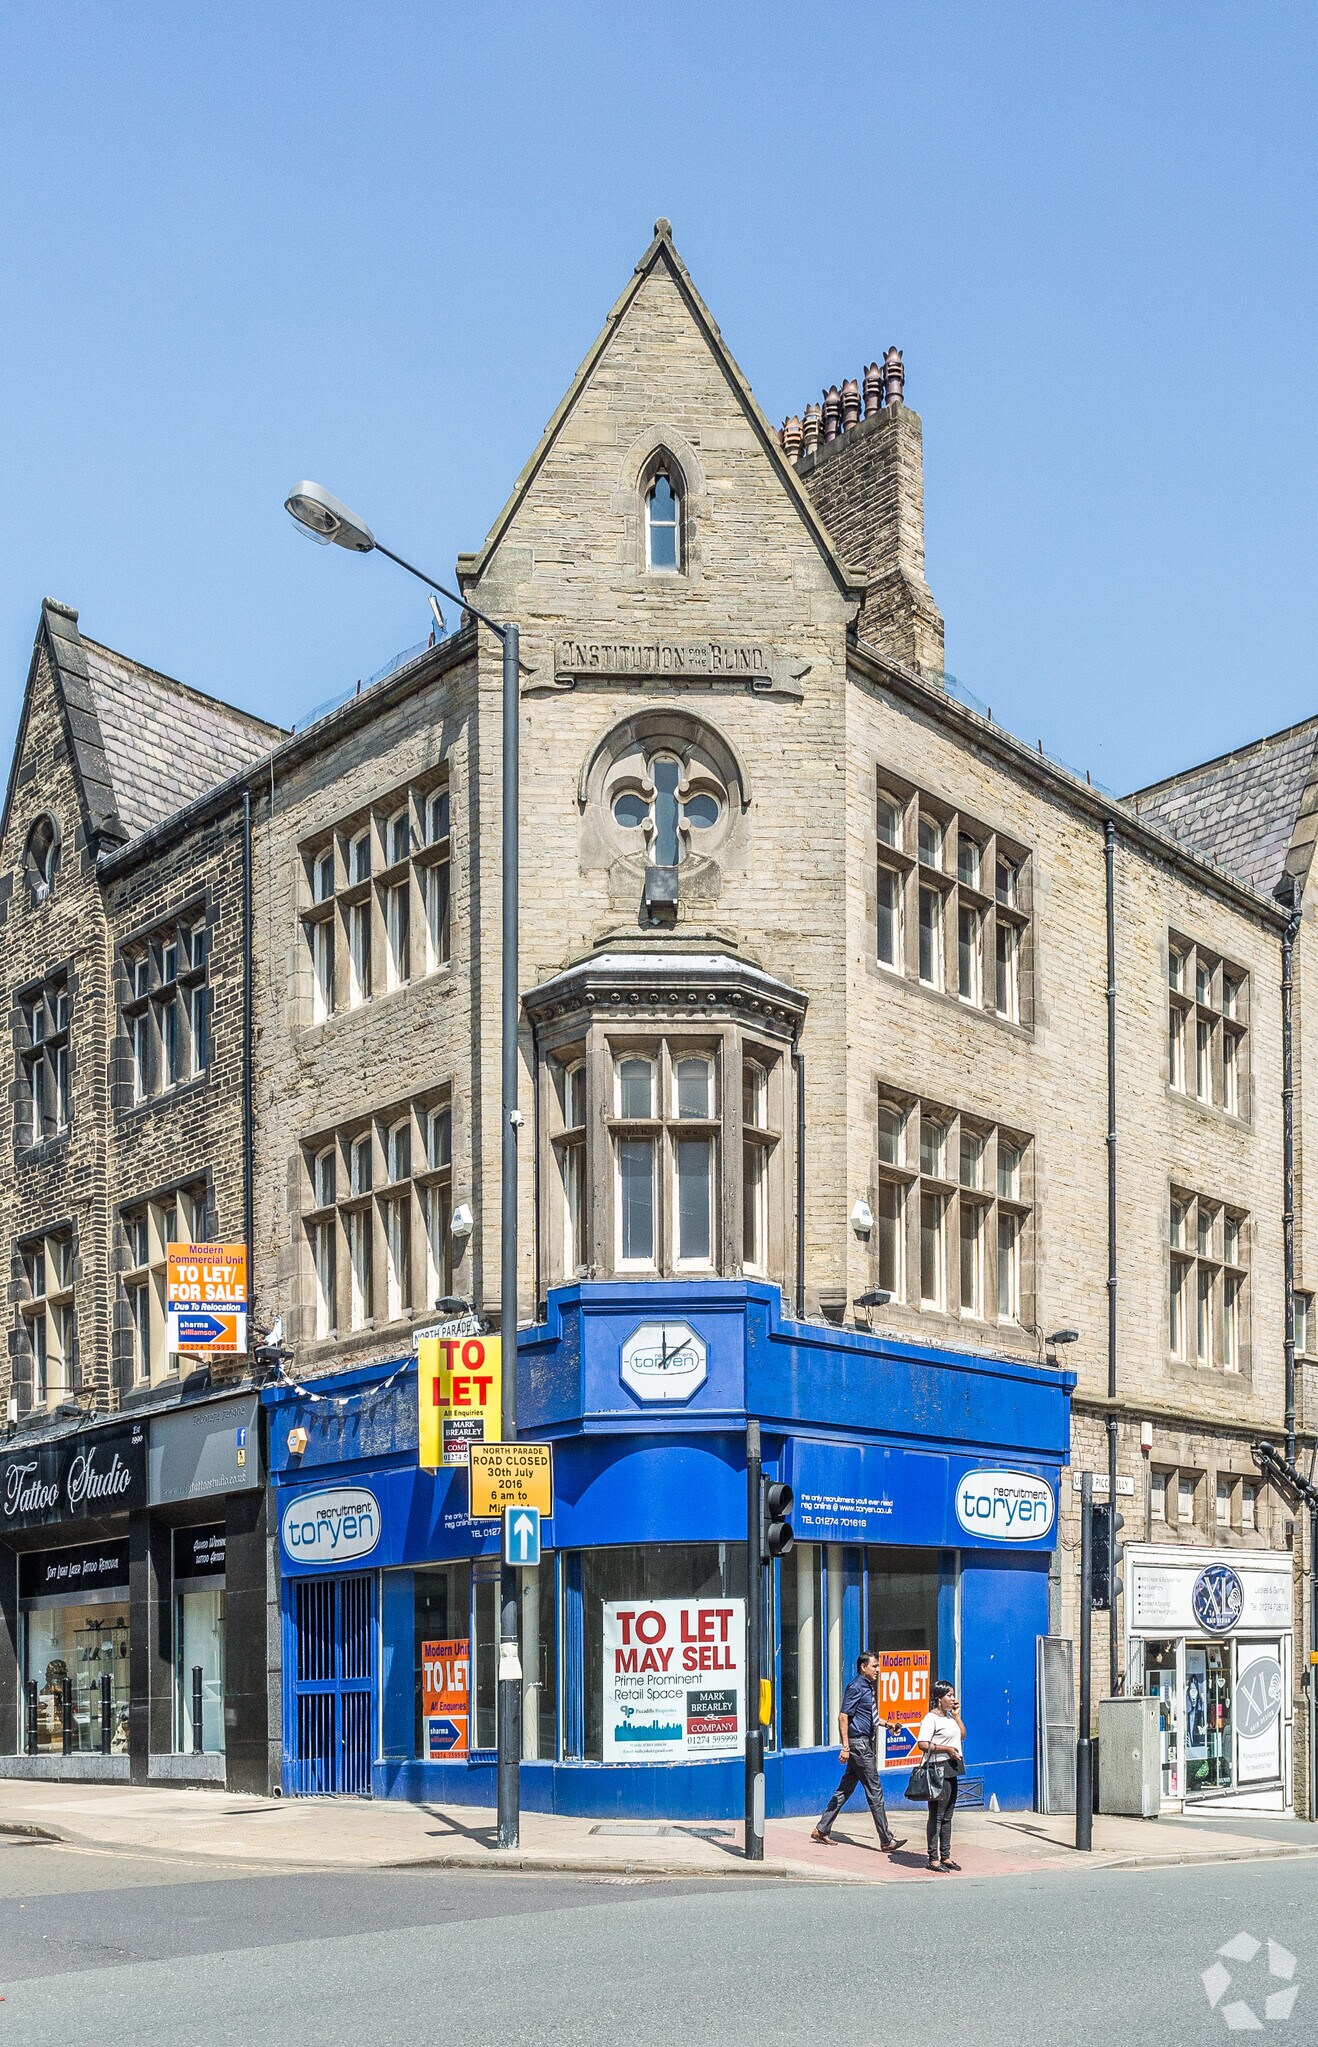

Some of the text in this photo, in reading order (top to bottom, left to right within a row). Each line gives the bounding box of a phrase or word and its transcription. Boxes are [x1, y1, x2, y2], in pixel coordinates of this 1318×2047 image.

[562, 640, 685, 669] INSTITUTION
[688, 648, 707, 656] FOR
[688, 659, 707, 667] THE
[189, 1245, 224, 1254] Modern
[169, 1255, 244, 1265] Commercial Unit
[176, 1265, 237, 1284] TO LET/
[169, 1284, 245, 1301] FOR SALE
[174, 1302, 241, 1311] Due To Relocation
[440, 1339, 486, 1371] TO
[432, 1375, 493, 1407] LET
[454, 1409, 484, 1417] Enquiries
[445, 1428, 482, 1436] BREARLEY
[447, 1444, 468, 1452] COMP
[513, 1447, 544, 1455] PARADE
[473, 1456, 503, 1466] ROAD
[505, 1456, 548, 1466] CLOSED
[487, 1467, 534, 1479] 30th July
[4, 1461, 59, 1515] Tattoo
[67, 1446, 132, 1513] Studio
[498, 1479, 523, 1489] 2016
[1095, 1478, 1129, 1490] PICCILLY
[491, 1491, 497, 1500] 6
[517, 1492, 528, 1500] to
[993, 1486, 1048, 1501] recruitment
[801, 1493, 810, 1501] the
[811, 1494, 823, 1503] only
[823, 1496, 855, 1504] recruitment
[880, 1499, 894, 1507] need
[316, 1502, 372, 1519] recruitment
[800, 1502, 893, 1515] reg online @ www.toryen.co.uk
[962, 1490, 1048, 1526] toryen
[453, 1512, 463, 1521] only
[801, 1515, 814, 1524] TEL
[815, 1516, 839, 1526] 01274
[444, 1522, 455, 1530] reg
[455, 1519, 472, 1528] online
[288, 1513, 374, 1549] toryen
[471, 1527, 502, 1538] TEL 0127
[1202, 1576, 1235, 1616] XL
[616, 1609, 734, 1645] TO LET
[425, 1643, 470, 1657] Modern Unit
[614, 1645, 737, 1673] MAY SELL
[882, 1654, 928, 1667] Modern Unit
[424, 1660, 470, 1693] TO LET
[615, 1673, 703, 1687] Prime Prominent
[881, 1670, 929, 1702] TO LET
[615, 1688, 684, 1702] Retail Space
[699, 1692, 725, 1701] MARK
[430, 1701, 467, 1713] All Enquiries
[691, 1702, 733, 1712] BREARLEY
[703, 1713, 722, 1721] &
[887, 1710, 922, 1722] All Enquiries
[430, 1727, 449, 1735] sharma
[690, 1722, 734, 1733] COMPANY
[687, 1734, 738, 1745] 01274 595999
